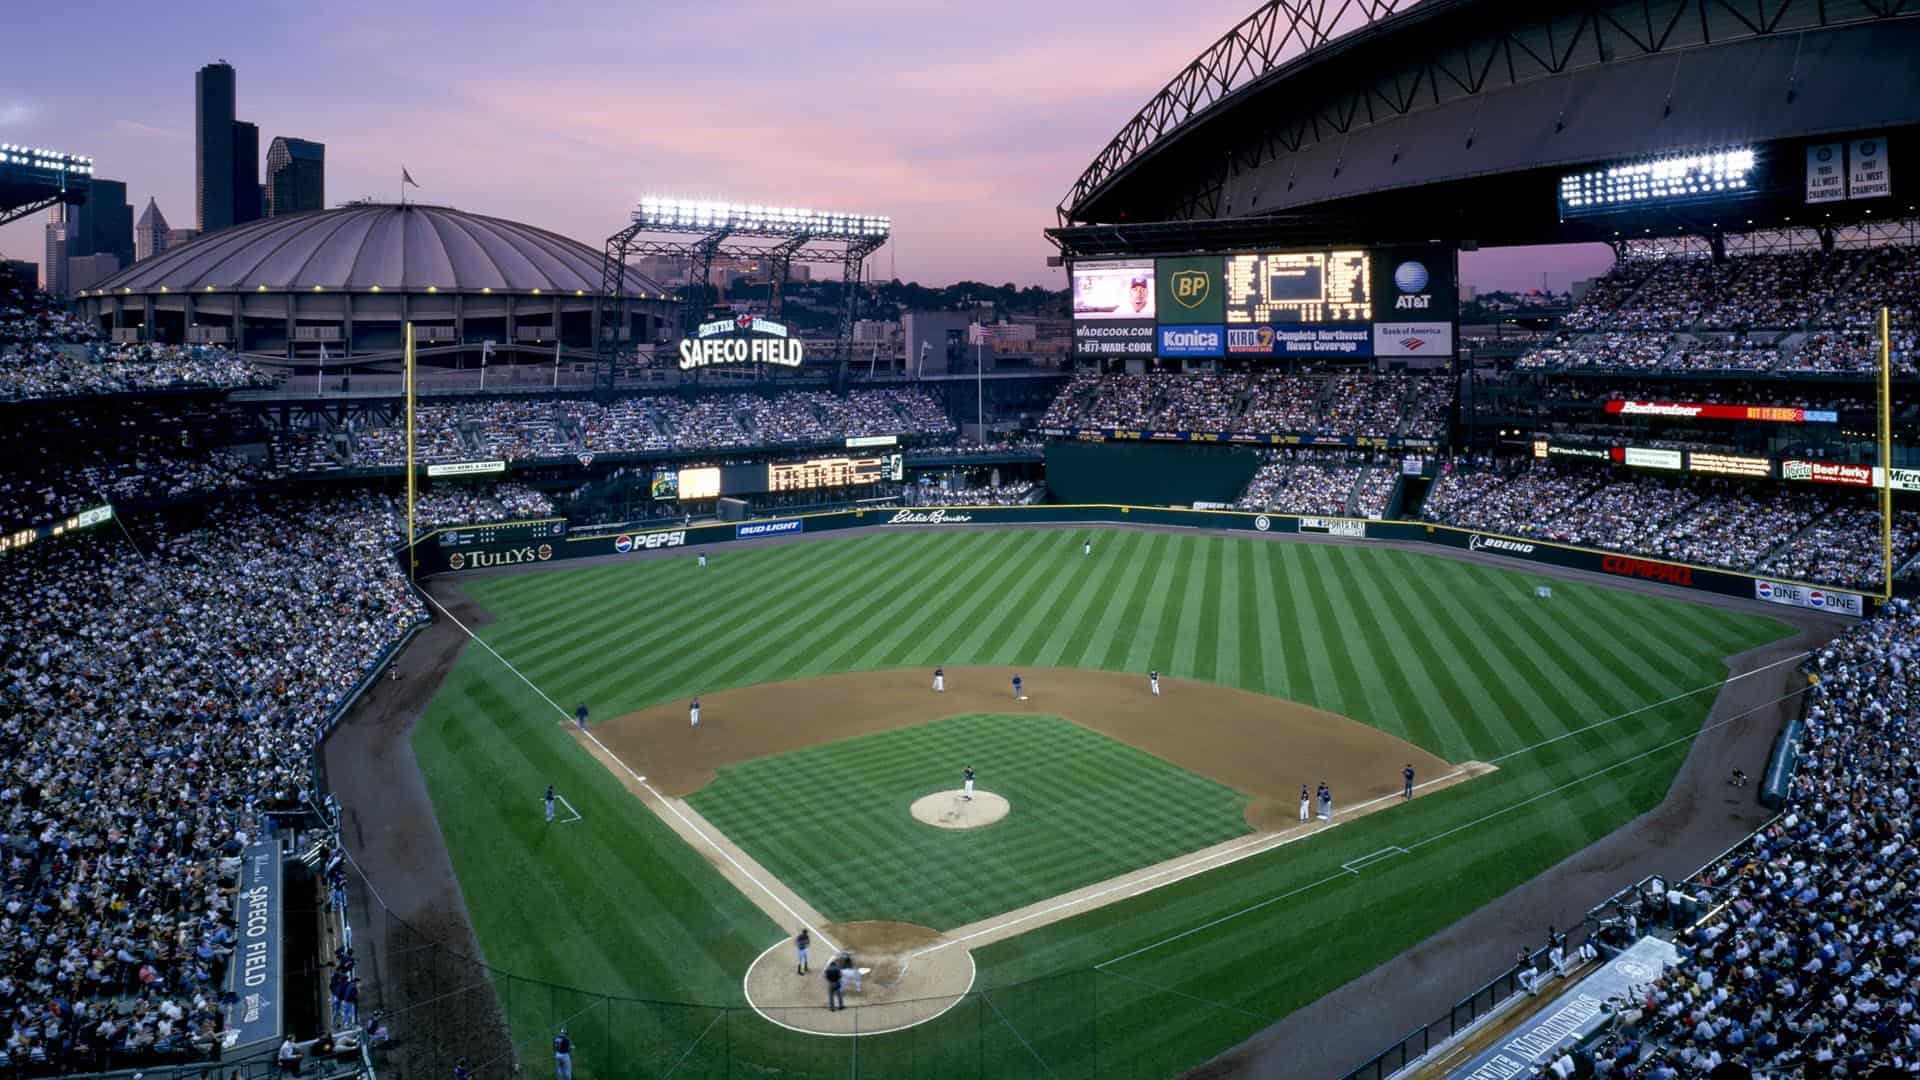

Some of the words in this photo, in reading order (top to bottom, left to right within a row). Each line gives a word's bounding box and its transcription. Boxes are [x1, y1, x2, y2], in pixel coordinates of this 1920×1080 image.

[1178, 277, 1205, 297] BP
[1395, 295, 1432, 309] AT&T
[1076, 325, 1153, 337] WADECOOK.COM
[1163, 329, 1219, 347] Konica
[1229, 331, 1256, 346] KIRO
[1276, 330, 1317, 342] Complete
[1318, 330, 1368, 341] Northwest
[679, 338, 748, 370] SAFECO
[751, 338, 803, 367] FIELD
[1286, 341, 1312, 351] News
[1313, 341, 1357, 352] Coverage
[1620, 401, 1703, 417] Budweiser
[1812, 463, 1839, 475] Beef
[1839, 465, 1870, 480] Jerky
[1889, 470, 1920, 482] Micr
[888, 509, 931, 523] Eddie
[740, 526, 765, 535] BUD
[765, 521, 800, 533] LIGHT
[632, 531, 687, 550] PEPSI
[1483, 538, 1534, 553] BOEING
[465, 546, 536, 568] TULLY'S
[1602, 554, 1692, 586] COMPAQ
[1773, 587, 1801, 601] ONE
[1826, 595, 1856, 610] ONE
[246, 885, 269, 938] SAFECO
[245, 941, 267, 987] FIELD
[1503, 993, 1603, 1062] MARINERS
